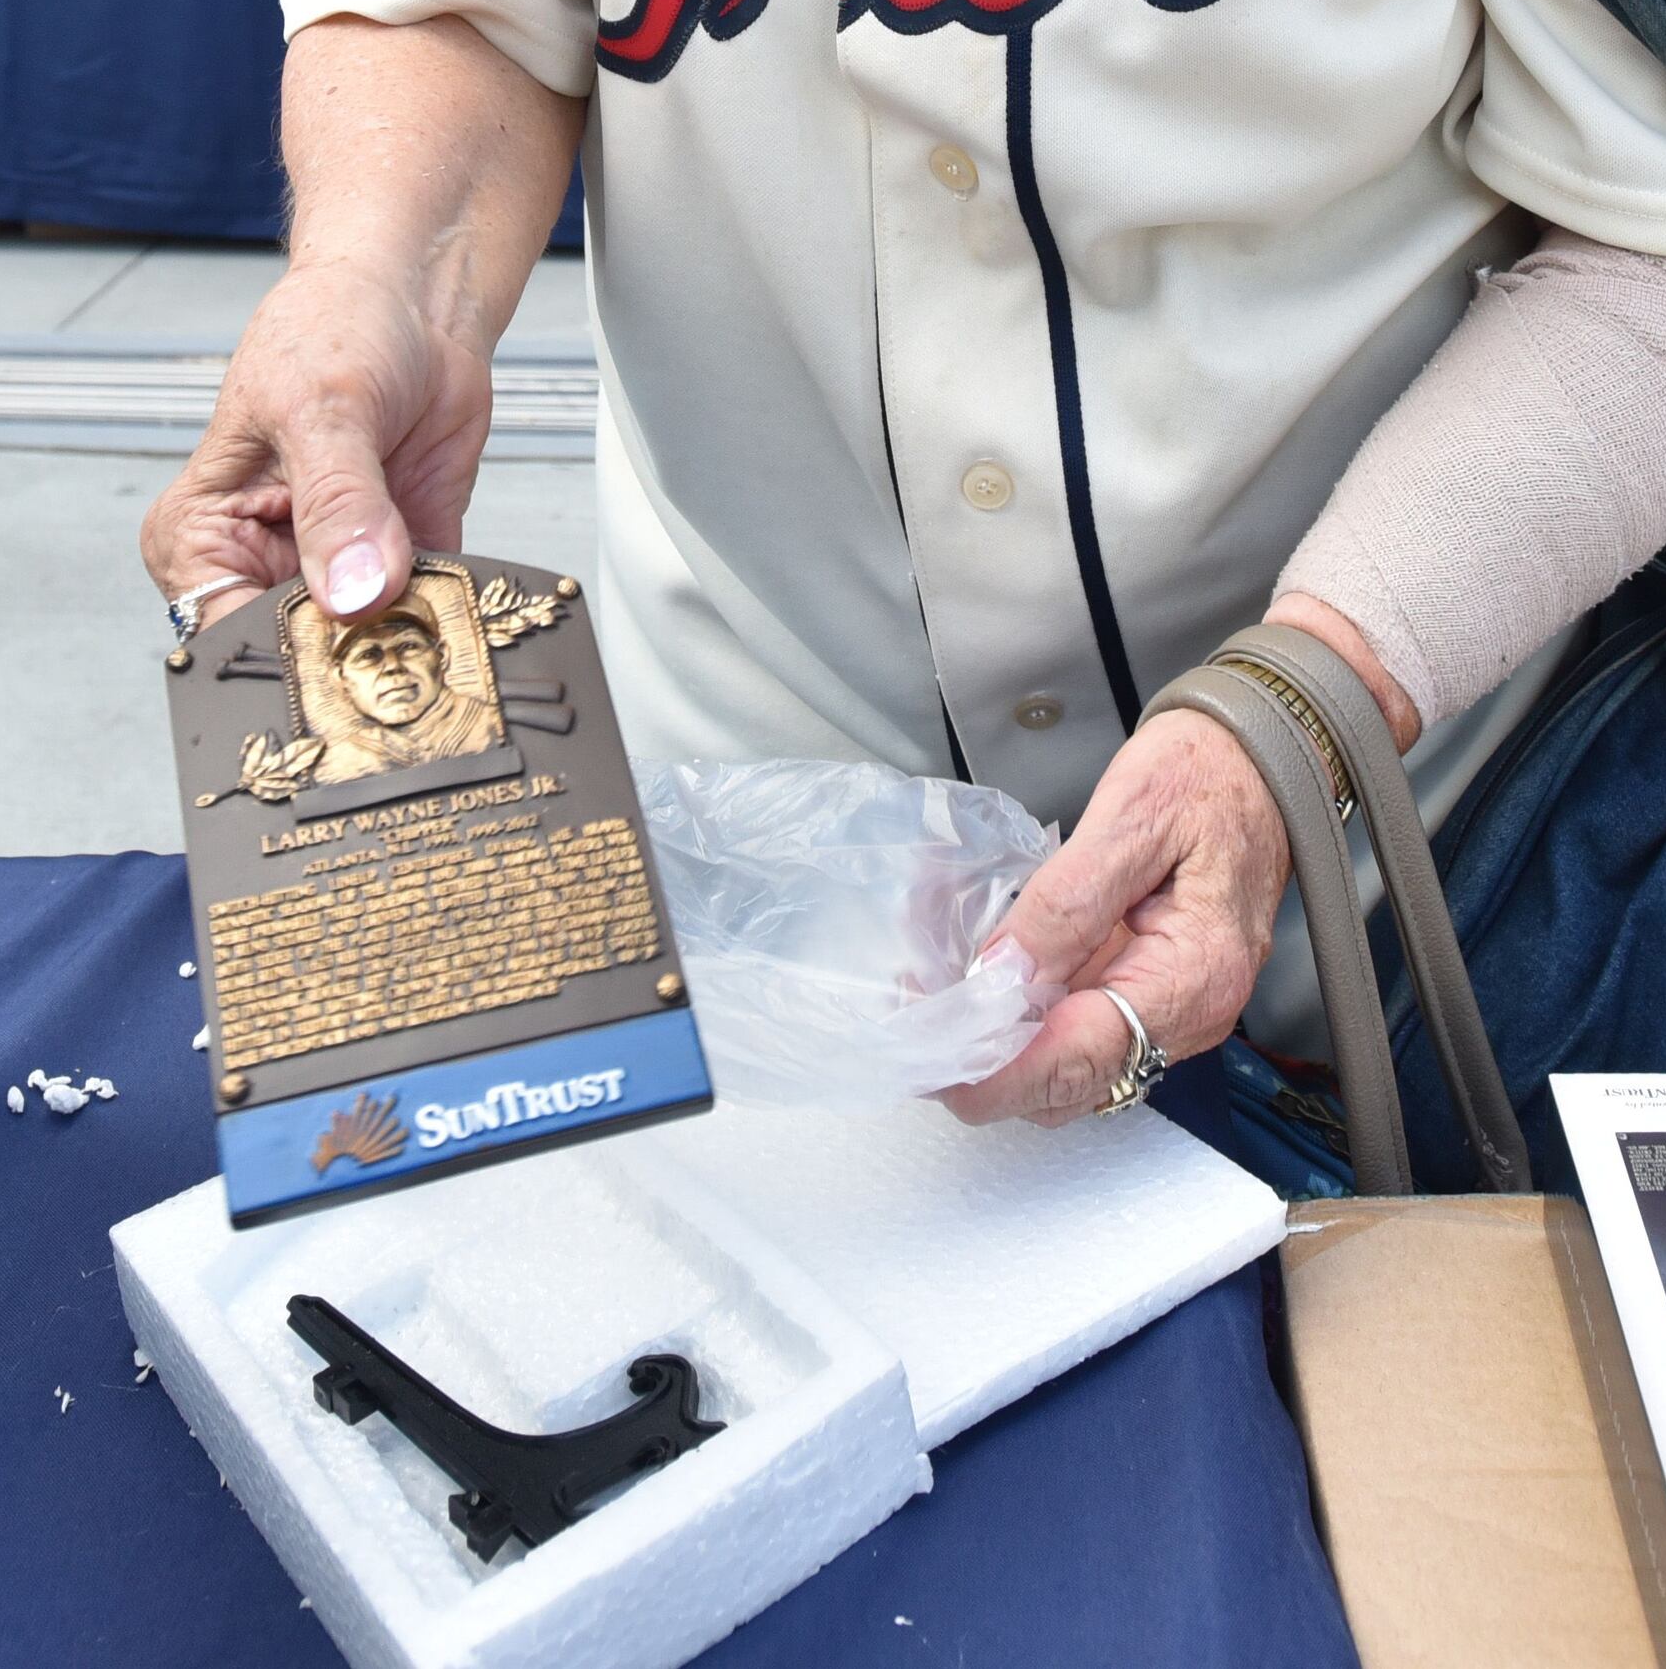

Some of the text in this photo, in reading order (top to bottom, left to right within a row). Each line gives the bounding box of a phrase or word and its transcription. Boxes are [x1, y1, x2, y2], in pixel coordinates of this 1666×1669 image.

[260, 776, 567, 856] LARRY WAYNE JONES JR.
